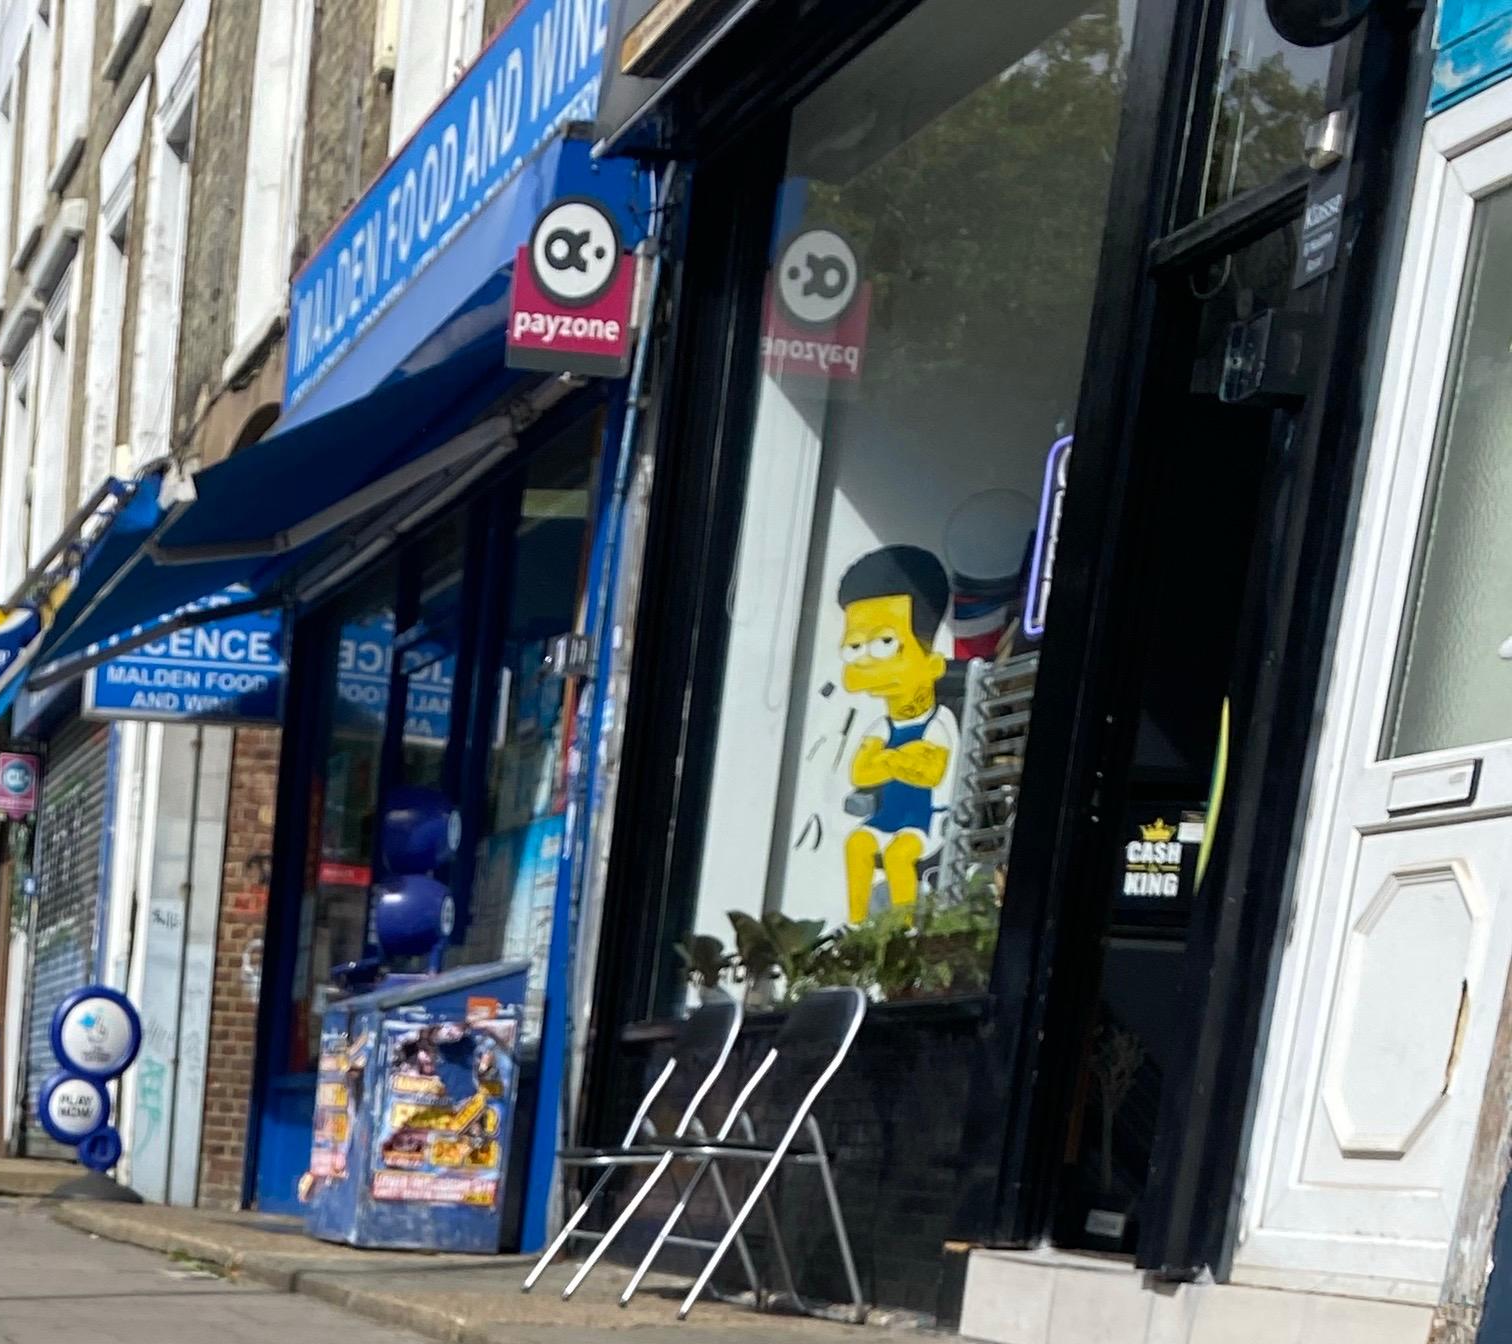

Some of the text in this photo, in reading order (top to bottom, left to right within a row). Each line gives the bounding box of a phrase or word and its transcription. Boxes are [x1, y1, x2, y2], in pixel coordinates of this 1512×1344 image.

[291, 210, 382, 378] MALDEN
[384, 122, 459, 282] FOOD
[460, 47, 524, 202] AND
[513, 310, 621, 343] payzone
[105, 664, 201, 690] MALDEN
[1126, 840, 1183, 864] CASH
[1123, 871, 1179, 897] KING
